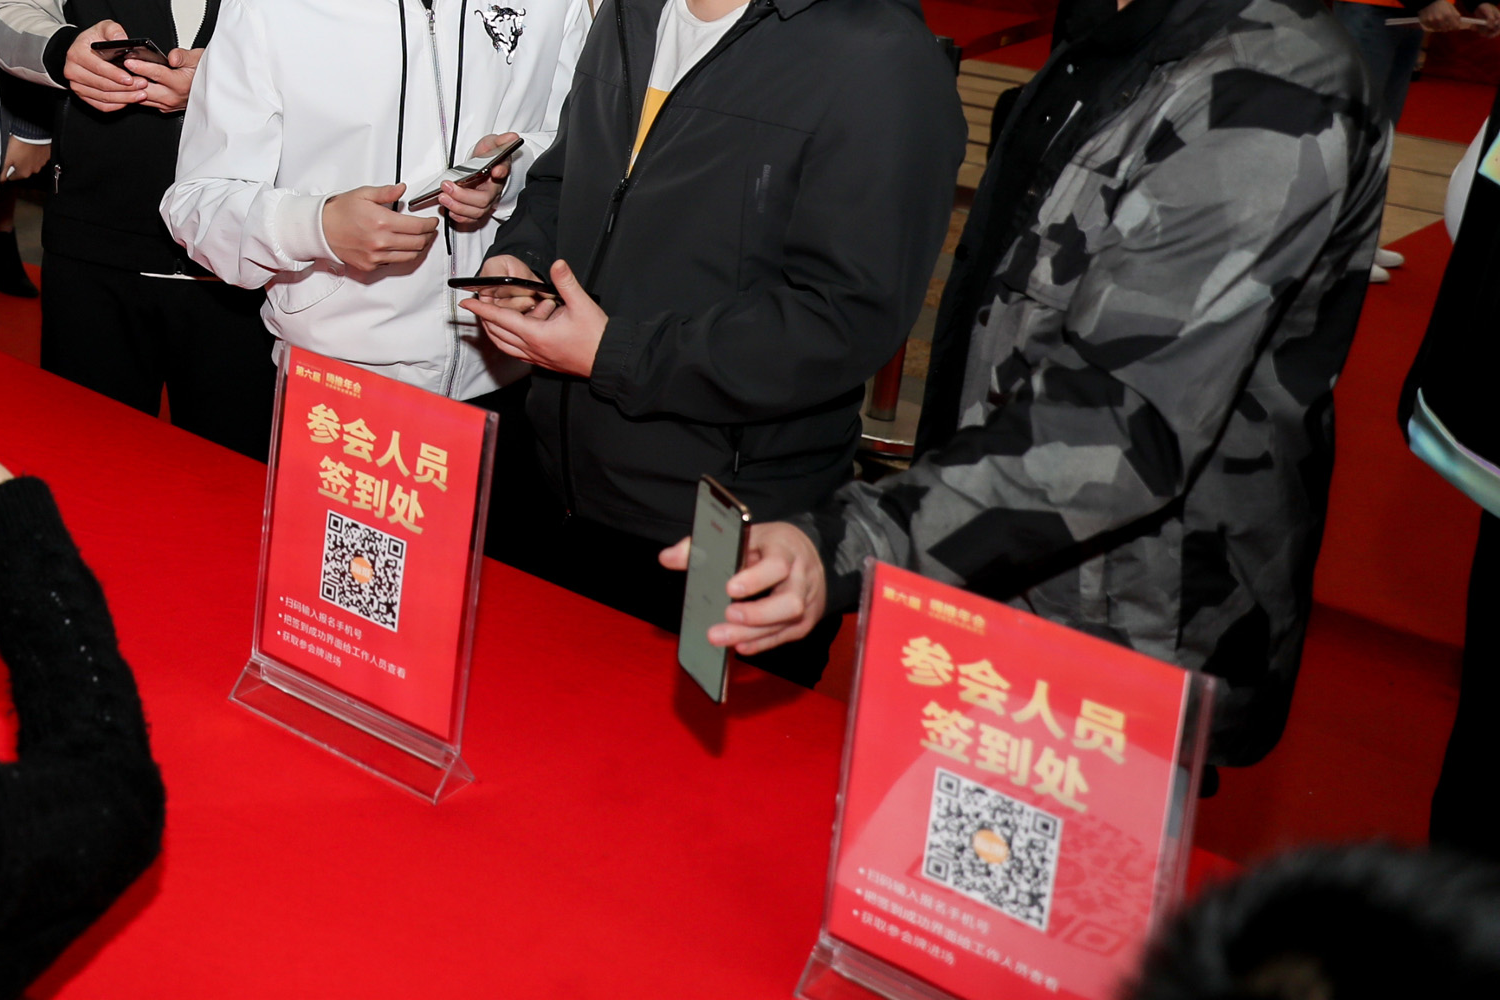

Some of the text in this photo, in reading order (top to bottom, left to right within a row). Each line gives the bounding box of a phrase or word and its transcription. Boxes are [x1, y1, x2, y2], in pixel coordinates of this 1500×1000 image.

[295, 365, 321, 383] 第六届
[306, 403, 449, 493] 参会人员
[318, 455, 425, 535] 签到处
[282, 630, 342, 667] 获取参会牌进场
[283, 613, 406, 679] 把签到成功界面给工作人员查看
[285, 596, 363, 640] 扫码输入报名手机号
[901, 636, 1127, 764] 参会人员
[920, 701, 1090, 813] 签到处
